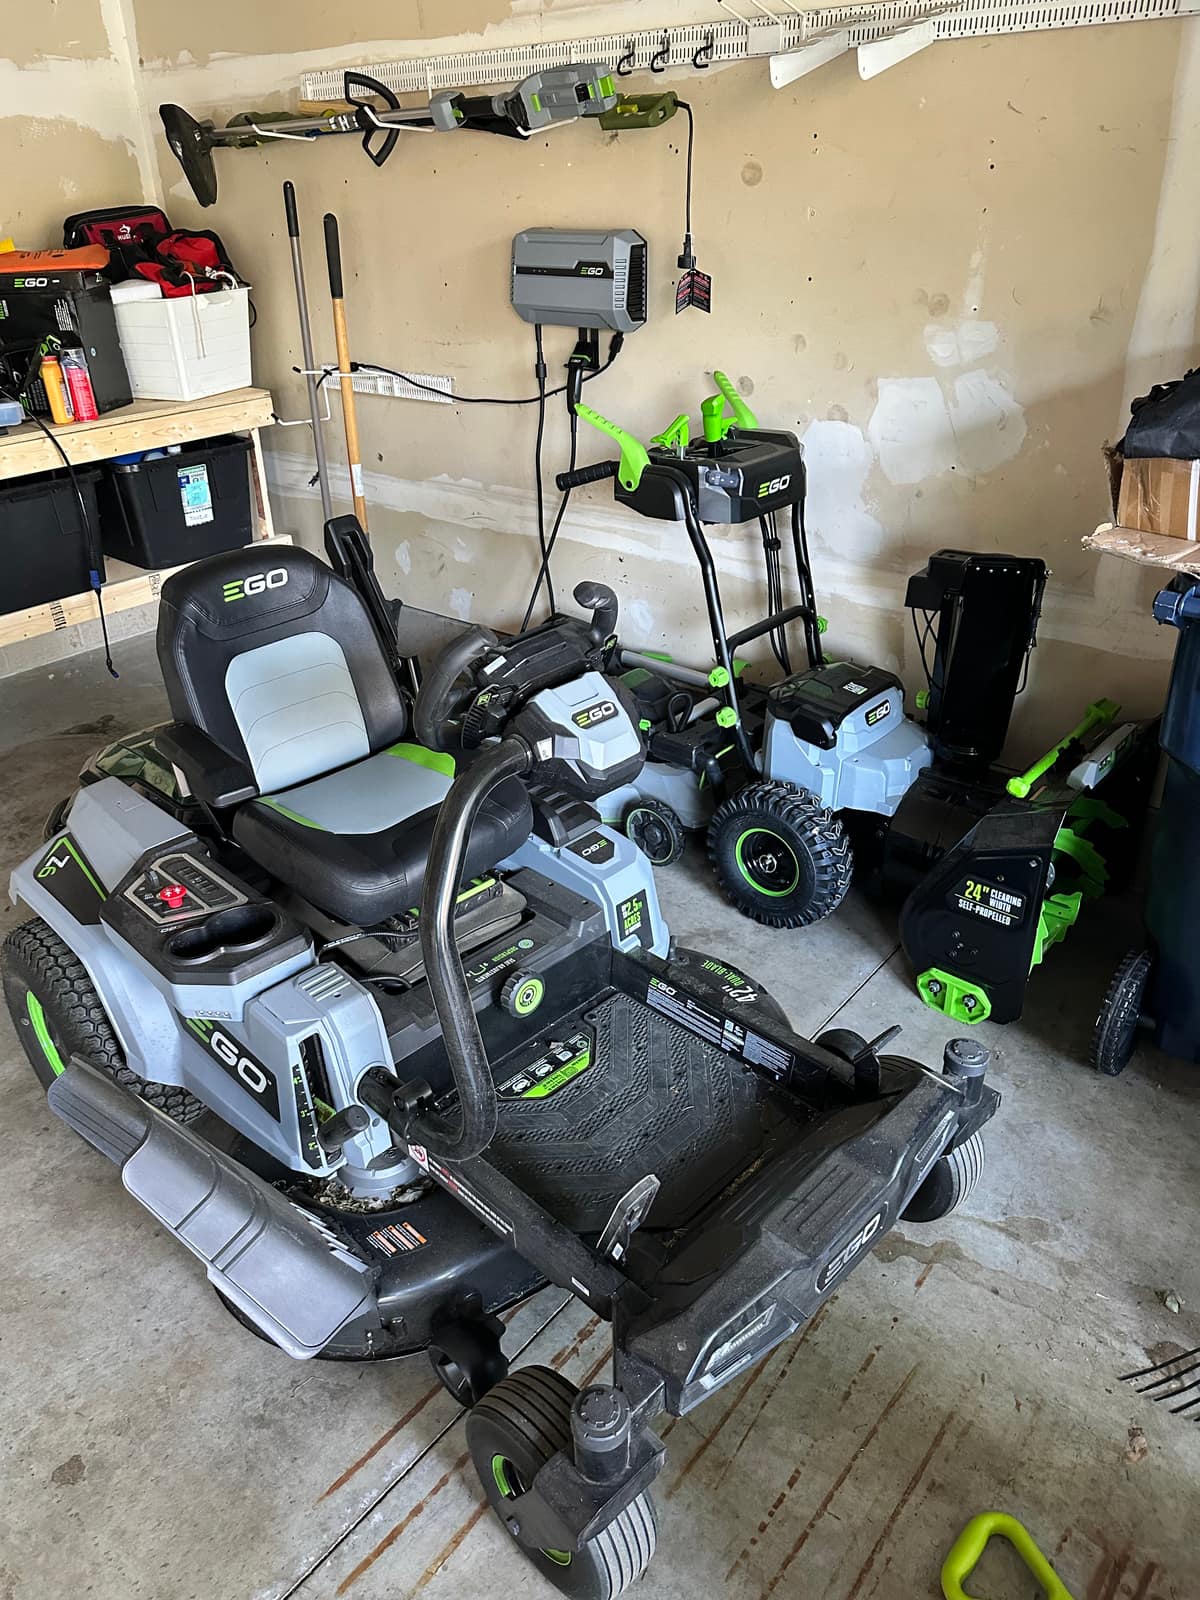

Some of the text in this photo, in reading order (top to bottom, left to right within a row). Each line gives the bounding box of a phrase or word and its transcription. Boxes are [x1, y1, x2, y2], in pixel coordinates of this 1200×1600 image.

[14, 277, 48, 288] EGO
[579, 266, 604, 276] EGO
[757, 474, 791, 498] EGO
[222, 567, 289, 603] EGO
[576, 702, 615, 727] EGO
[868, 702, 890, 725] EGO
[581, 839, 608, 857] EGO
[964, 880, 1022, 907] 24" CLEARING
[989, 897, 1012, 913] WIDTH
[624, 911, 641, 930] ACRES
[958, 899, 1011, 926] SELF-PROPELLED
[700, 960, 745, 987] DUAL-BLADE
[649, 977, 678, 996] EGO
[721, 985, 758, 1003] 42"
[186, 1018, 267, 1094] EGO
[824, 1213, 881, 1285] EGO
